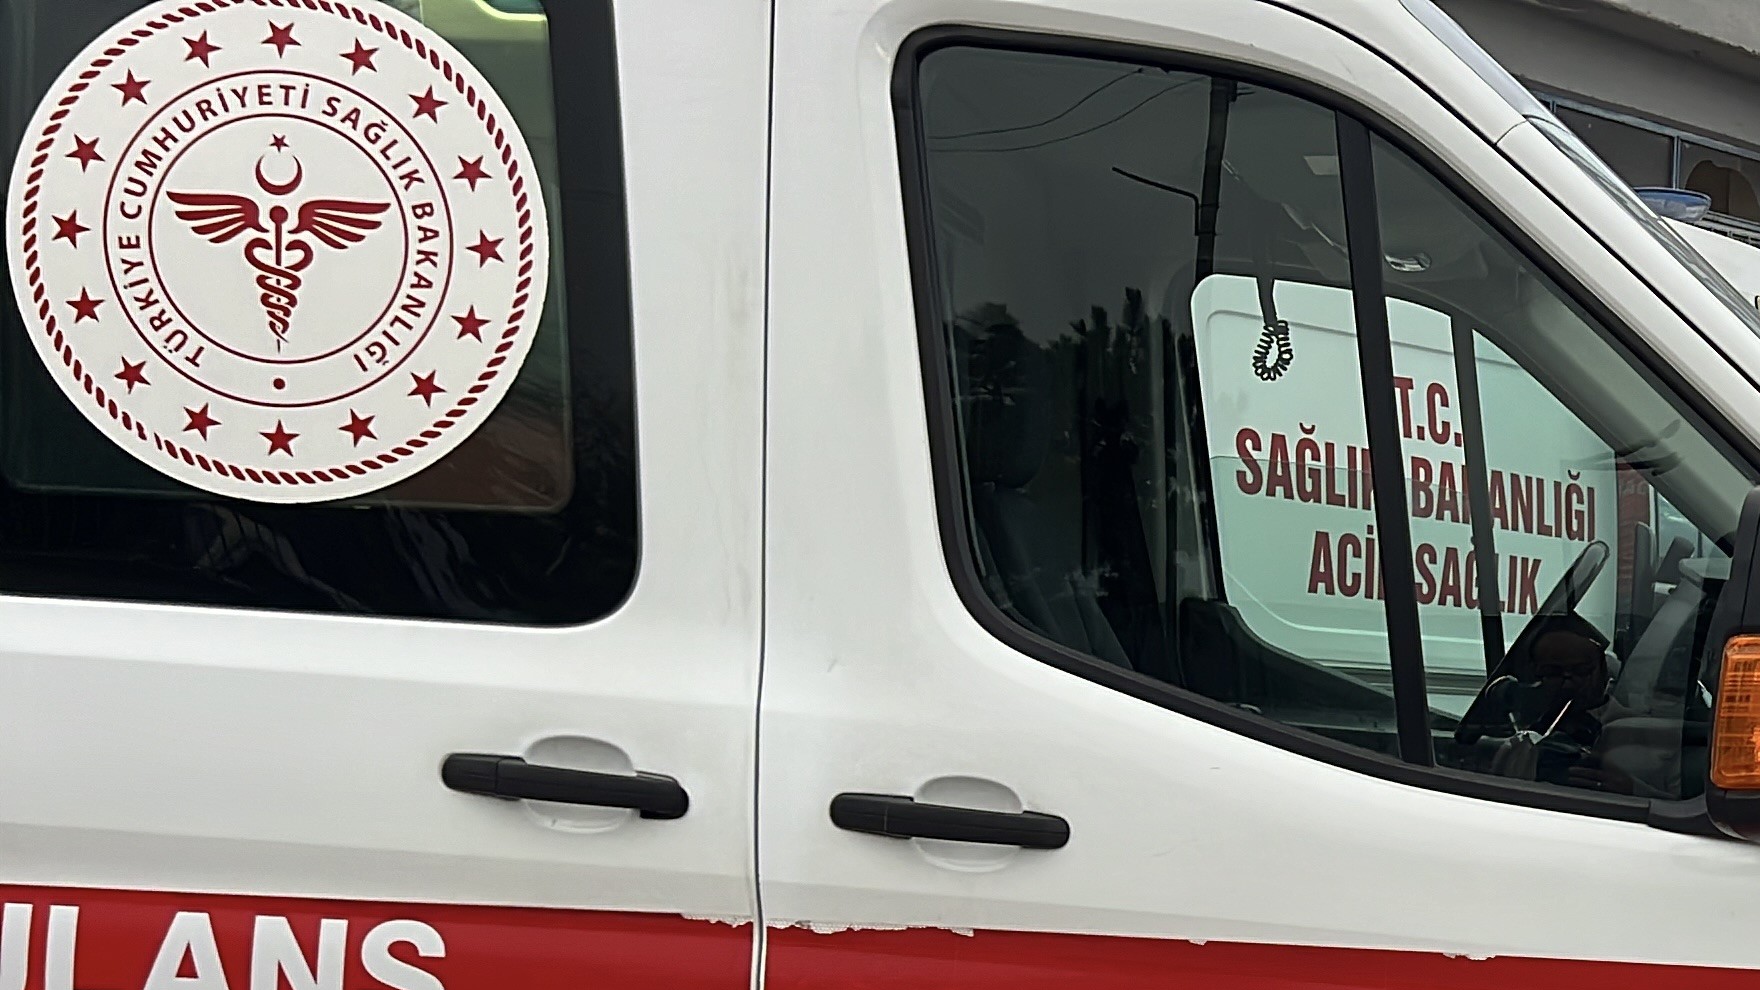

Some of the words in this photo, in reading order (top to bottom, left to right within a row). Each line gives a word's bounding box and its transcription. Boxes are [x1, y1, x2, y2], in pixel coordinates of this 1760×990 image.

[120, 82, 311, 220] CUMHURİYETİ
[321, 95, 427, 192] SAĞLIK
[117, 234, 206, 368] TÜRKİYE
[354, 201, 440, 373] BAKANLIĞI
[1393, 375, 1463, 447] T.C.
